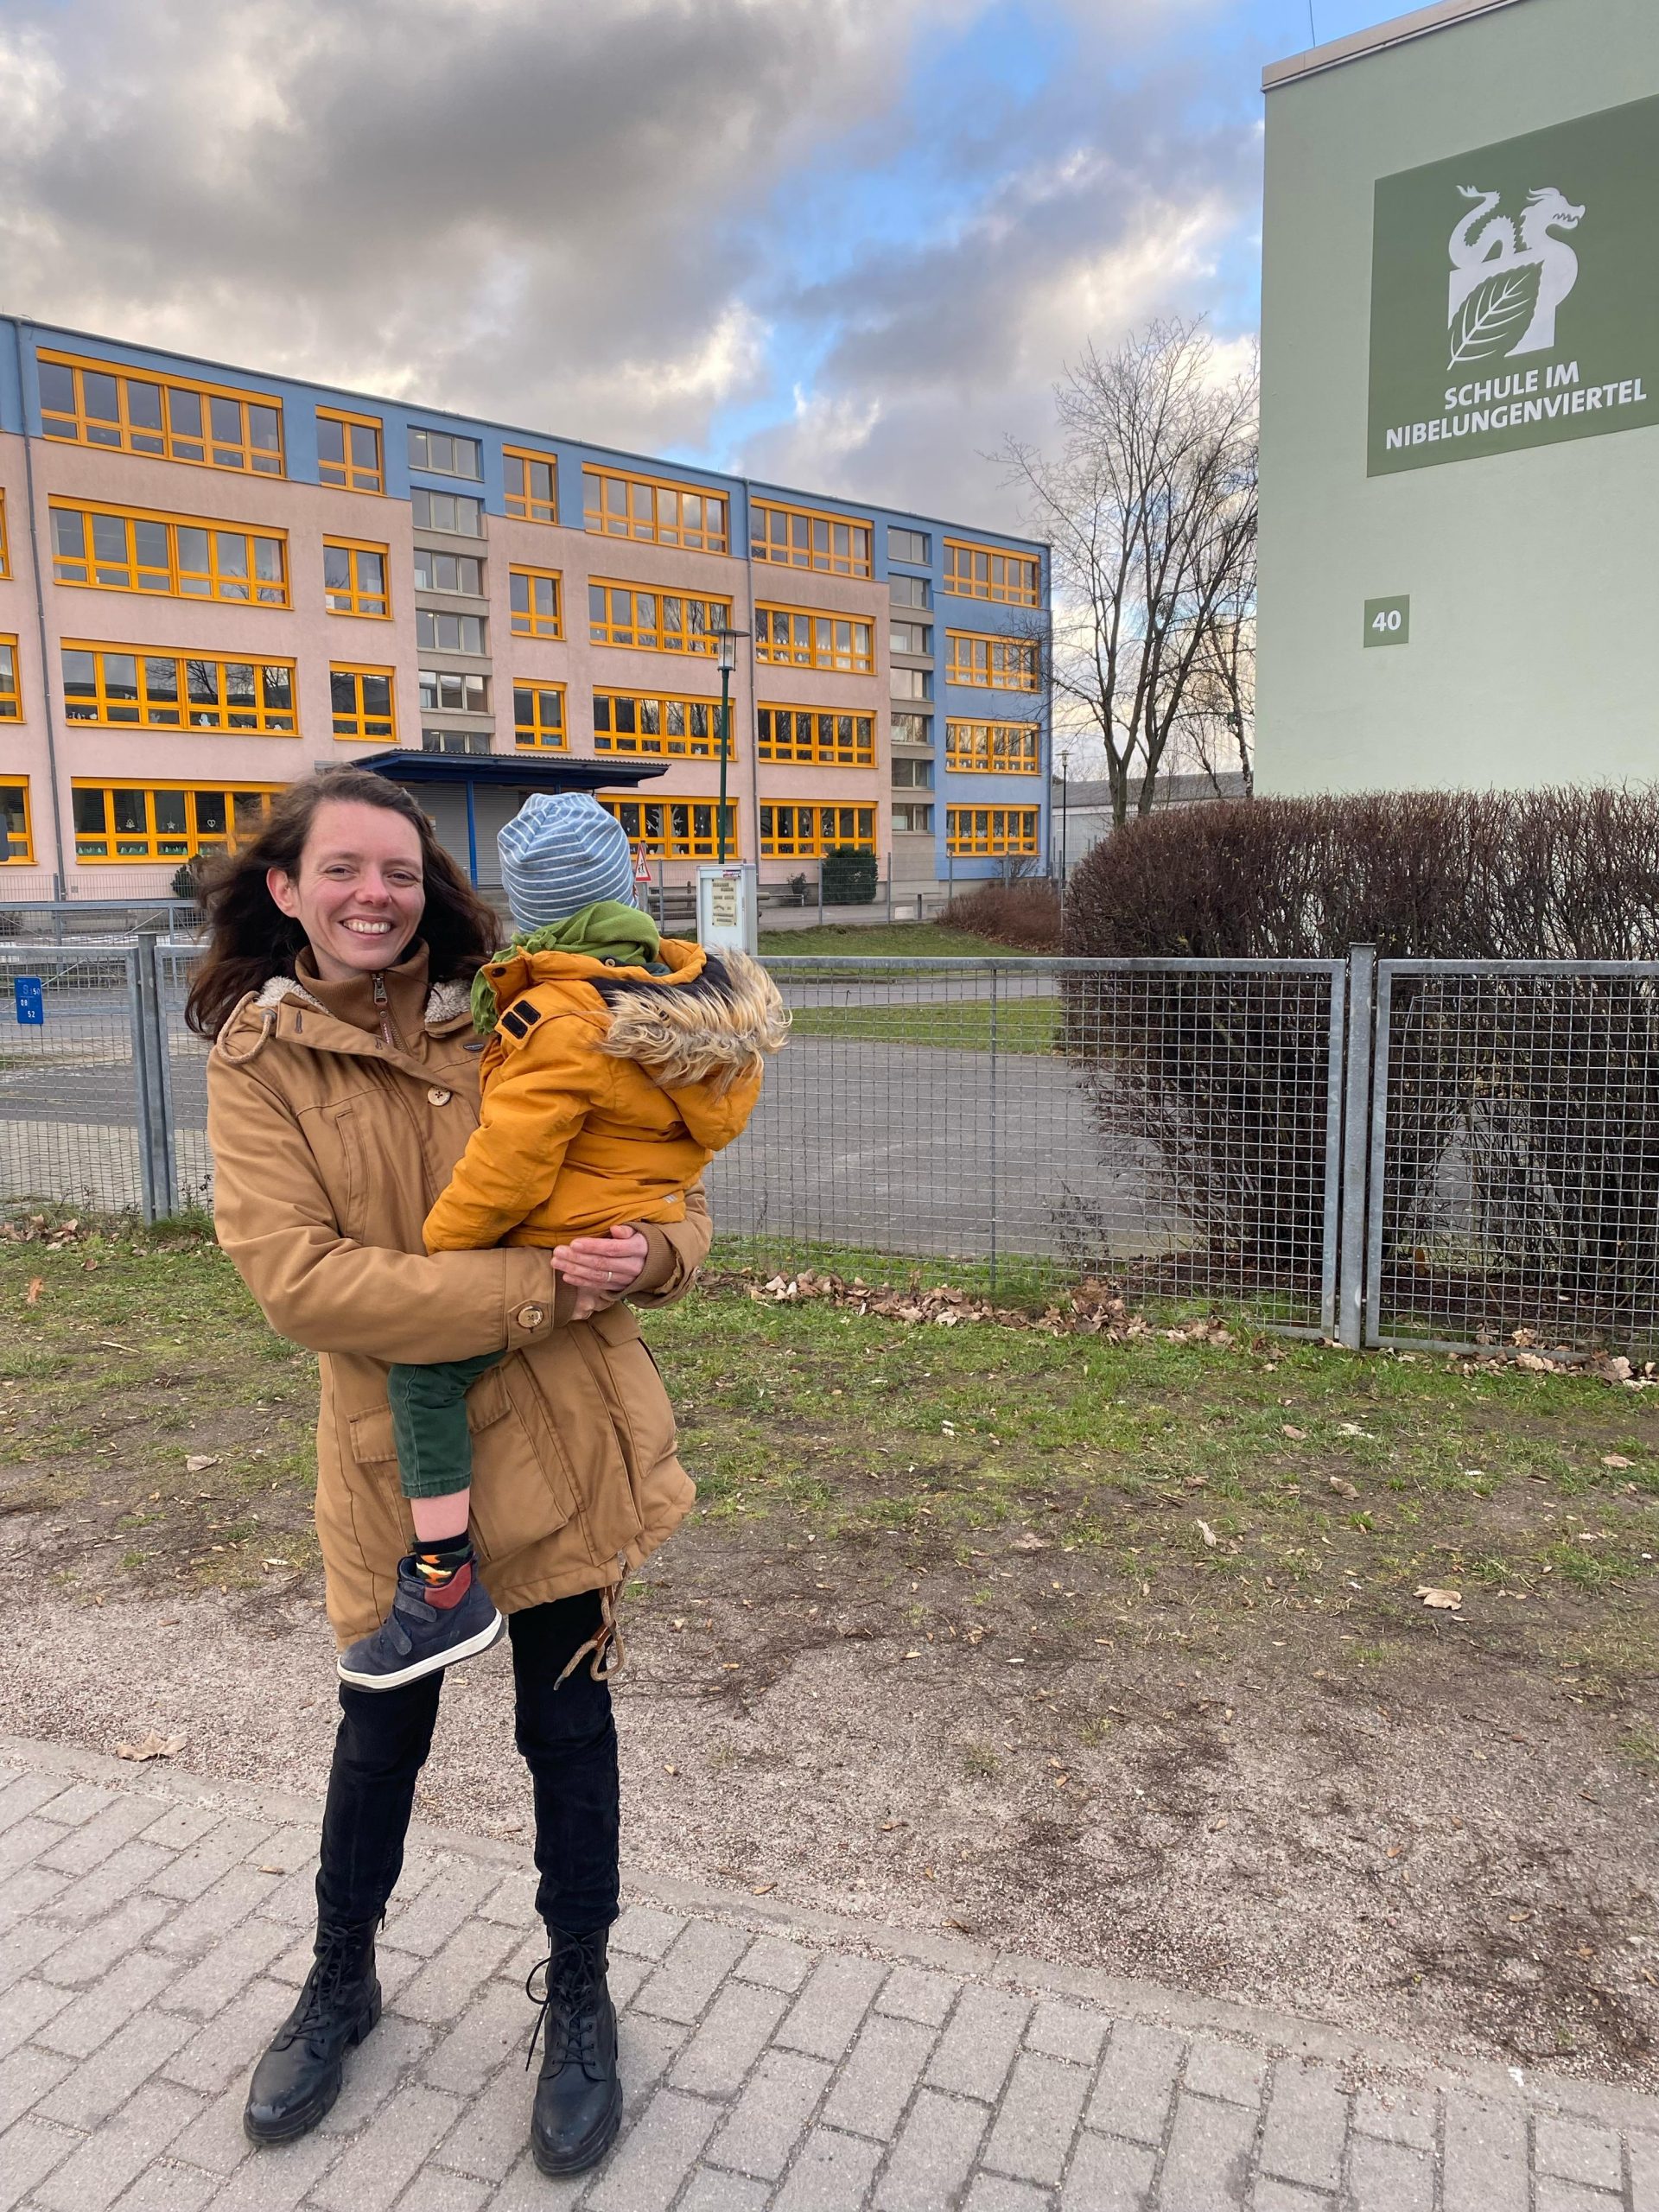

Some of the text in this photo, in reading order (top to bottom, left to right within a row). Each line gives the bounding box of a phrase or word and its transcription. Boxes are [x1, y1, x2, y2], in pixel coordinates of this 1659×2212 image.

[1444, 360, 1580, 410] SCHULE IM
[1385, 378, 1647, 449] NIBELUNGENVIERTEL
[1372, 610, 1402, 632] 40
